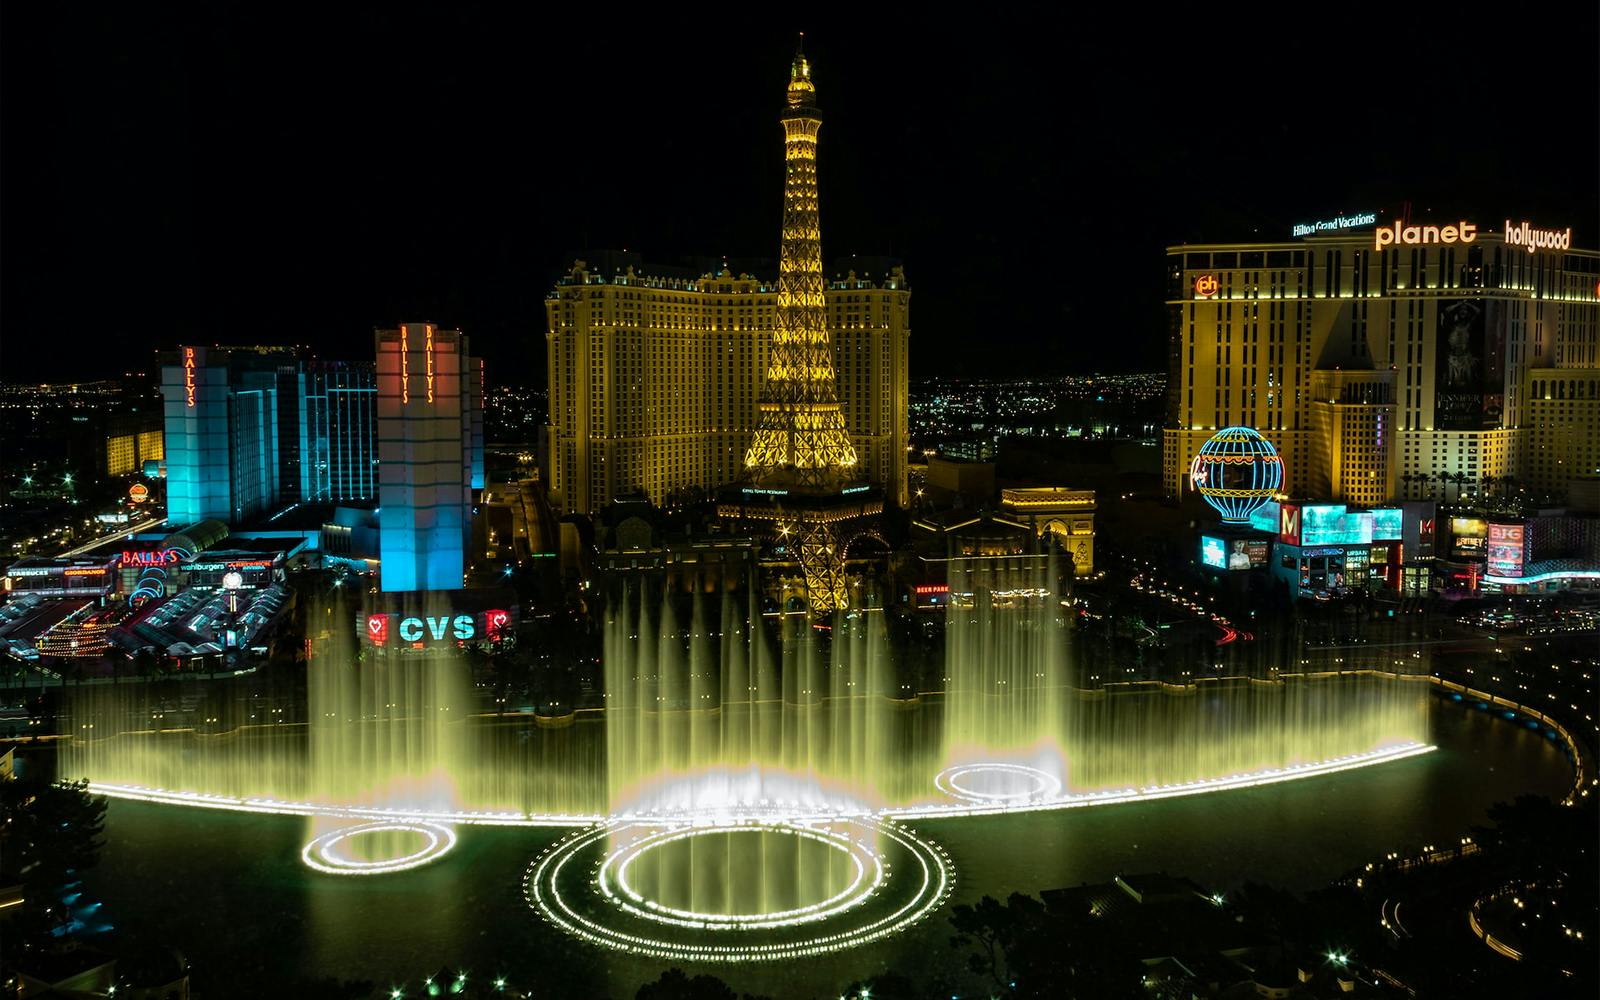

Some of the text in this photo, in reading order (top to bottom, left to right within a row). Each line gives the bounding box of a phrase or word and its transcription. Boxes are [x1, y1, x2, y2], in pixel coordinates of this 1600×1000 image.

[1293, 214, 1375, 236] Hilton Grand Vacations
[1375, 220, 1477, 251] planet
[1505, 220, 1571, 253] hollywood
[1282, 508, 1298, 536] M
[122, 550, 178, 564] BALLY'S
[180, 563, 225, 571] wahlburgers
[916, 586, 932, 594] BEER
[400, 614, 475, 642] CVS
